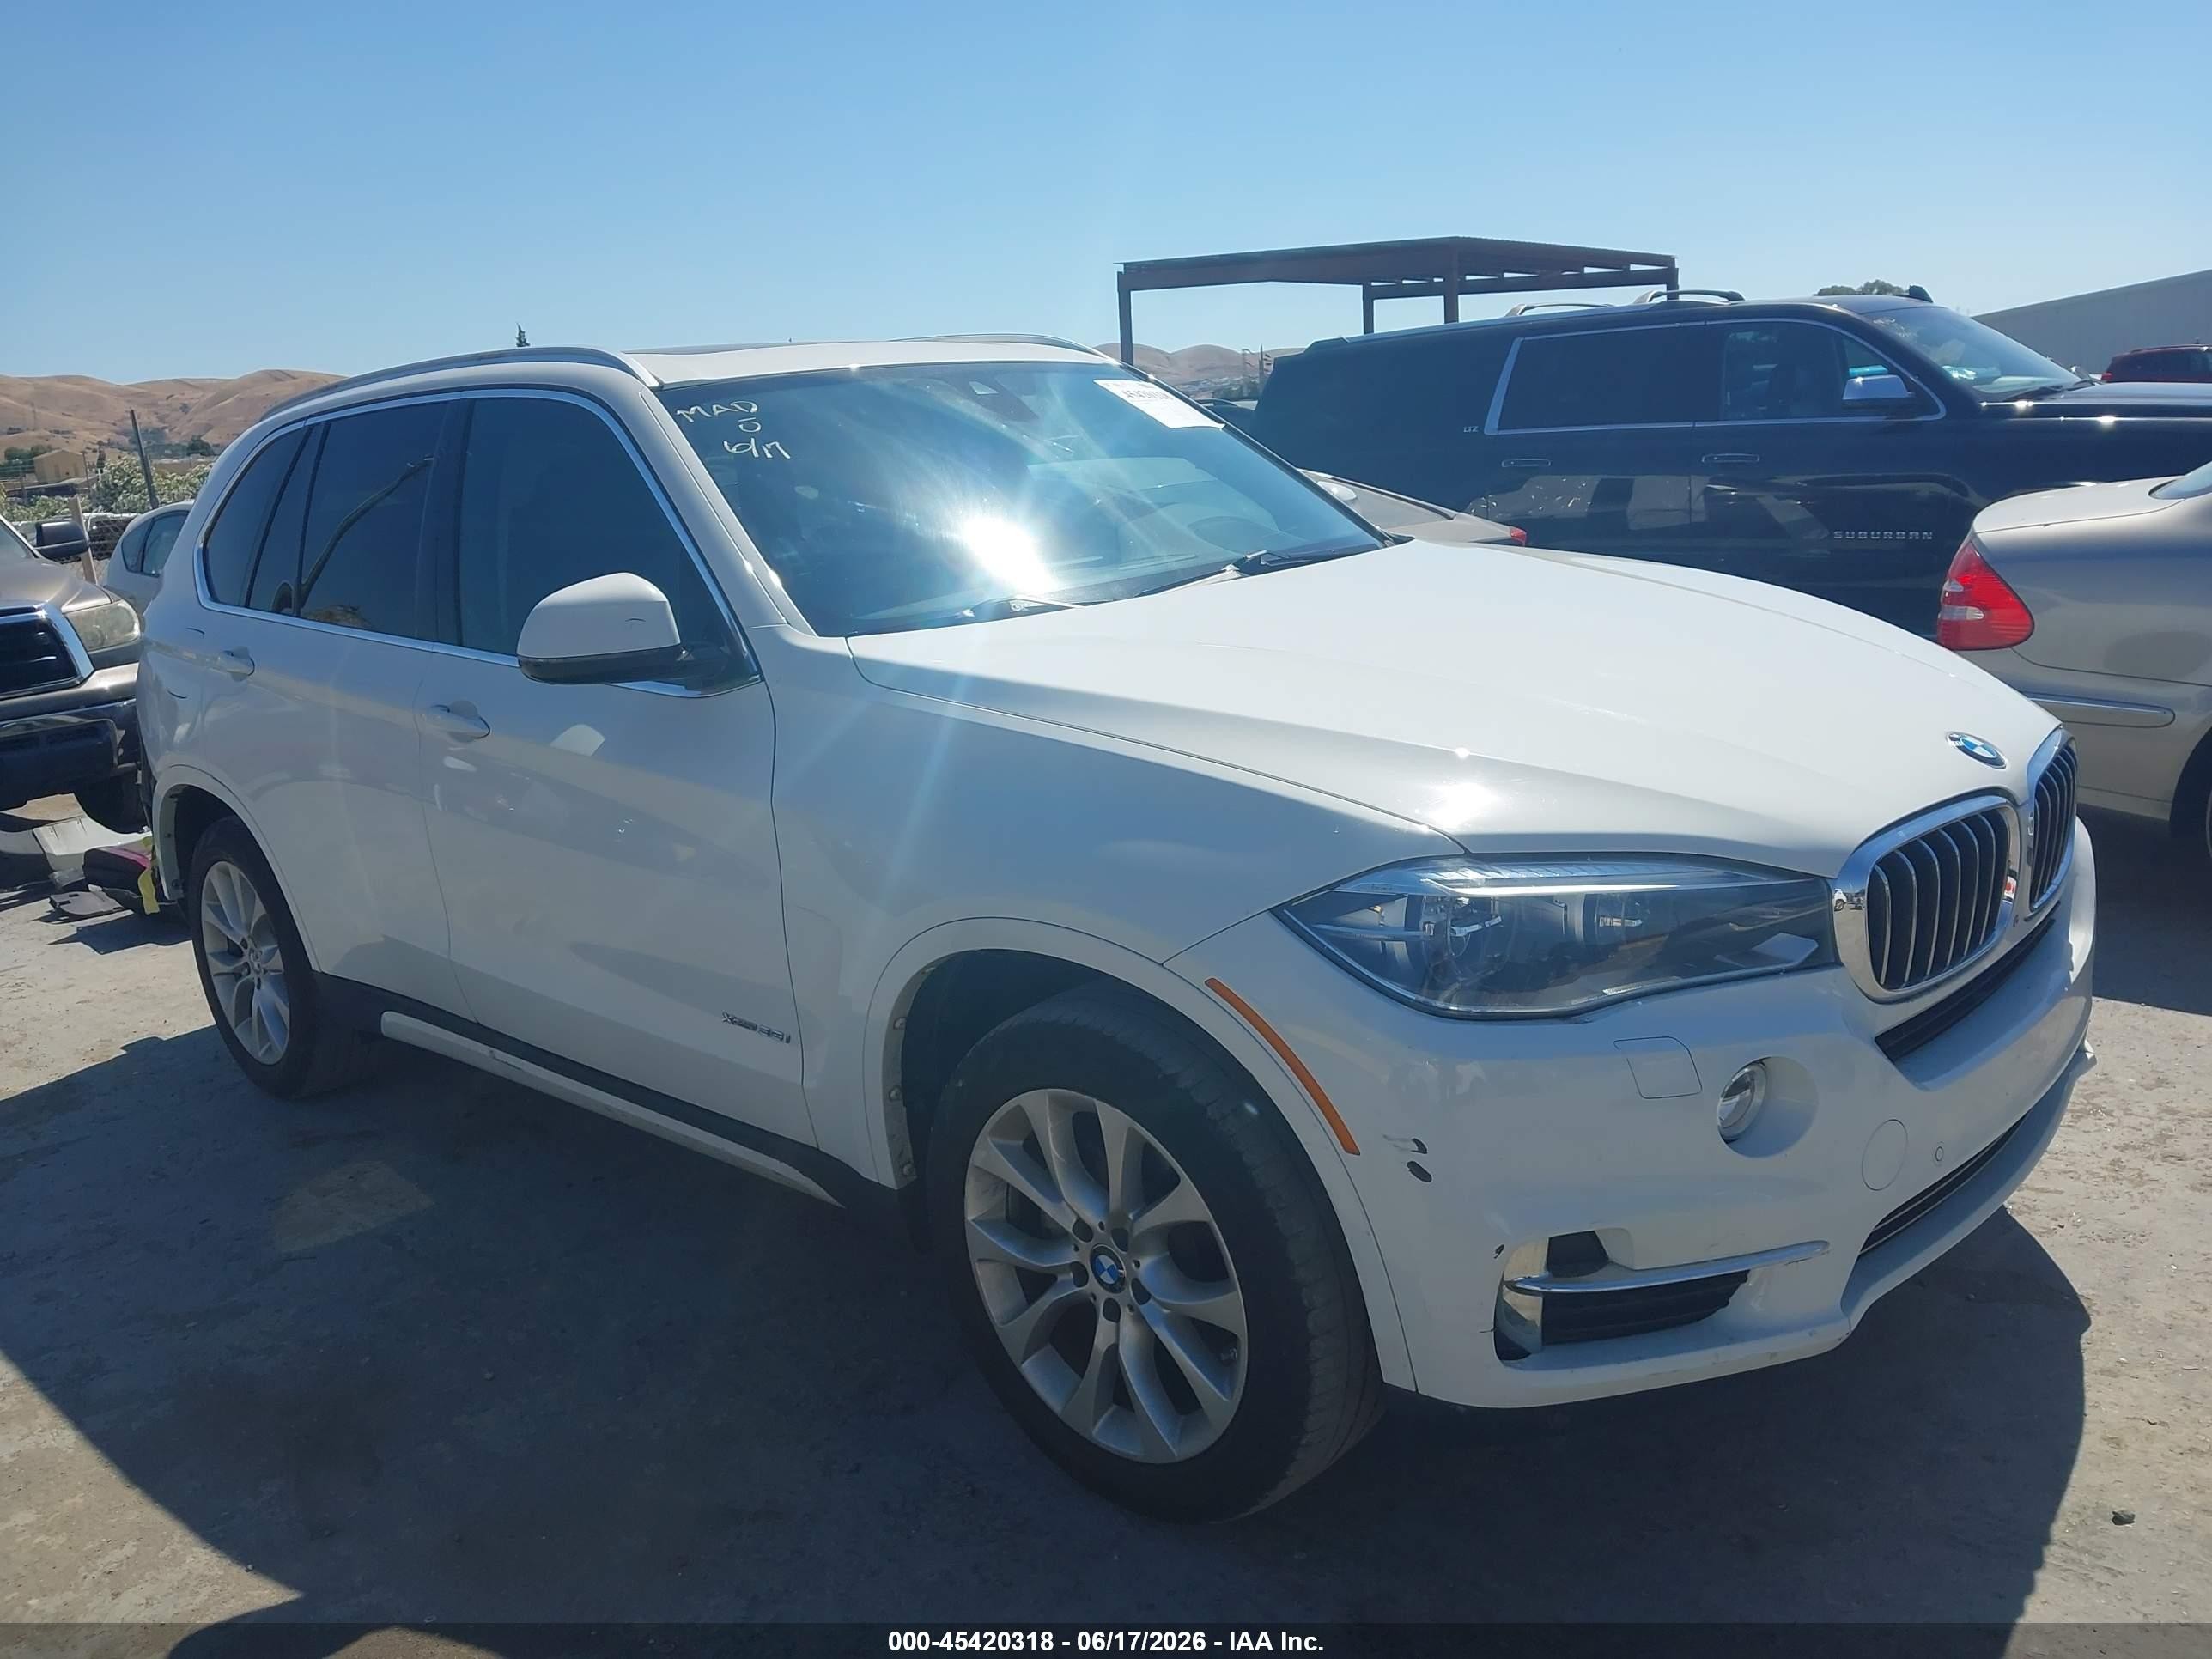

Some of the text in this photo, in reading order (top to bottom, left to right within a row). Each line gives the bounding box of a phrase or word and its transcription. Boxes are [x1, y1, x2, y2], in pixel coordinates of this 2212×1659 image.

[676, 400, 758, 422] MAD
[723, 437, 791, 459] 6/17
[1833, 531, 1933, 540] SUBURBAN
